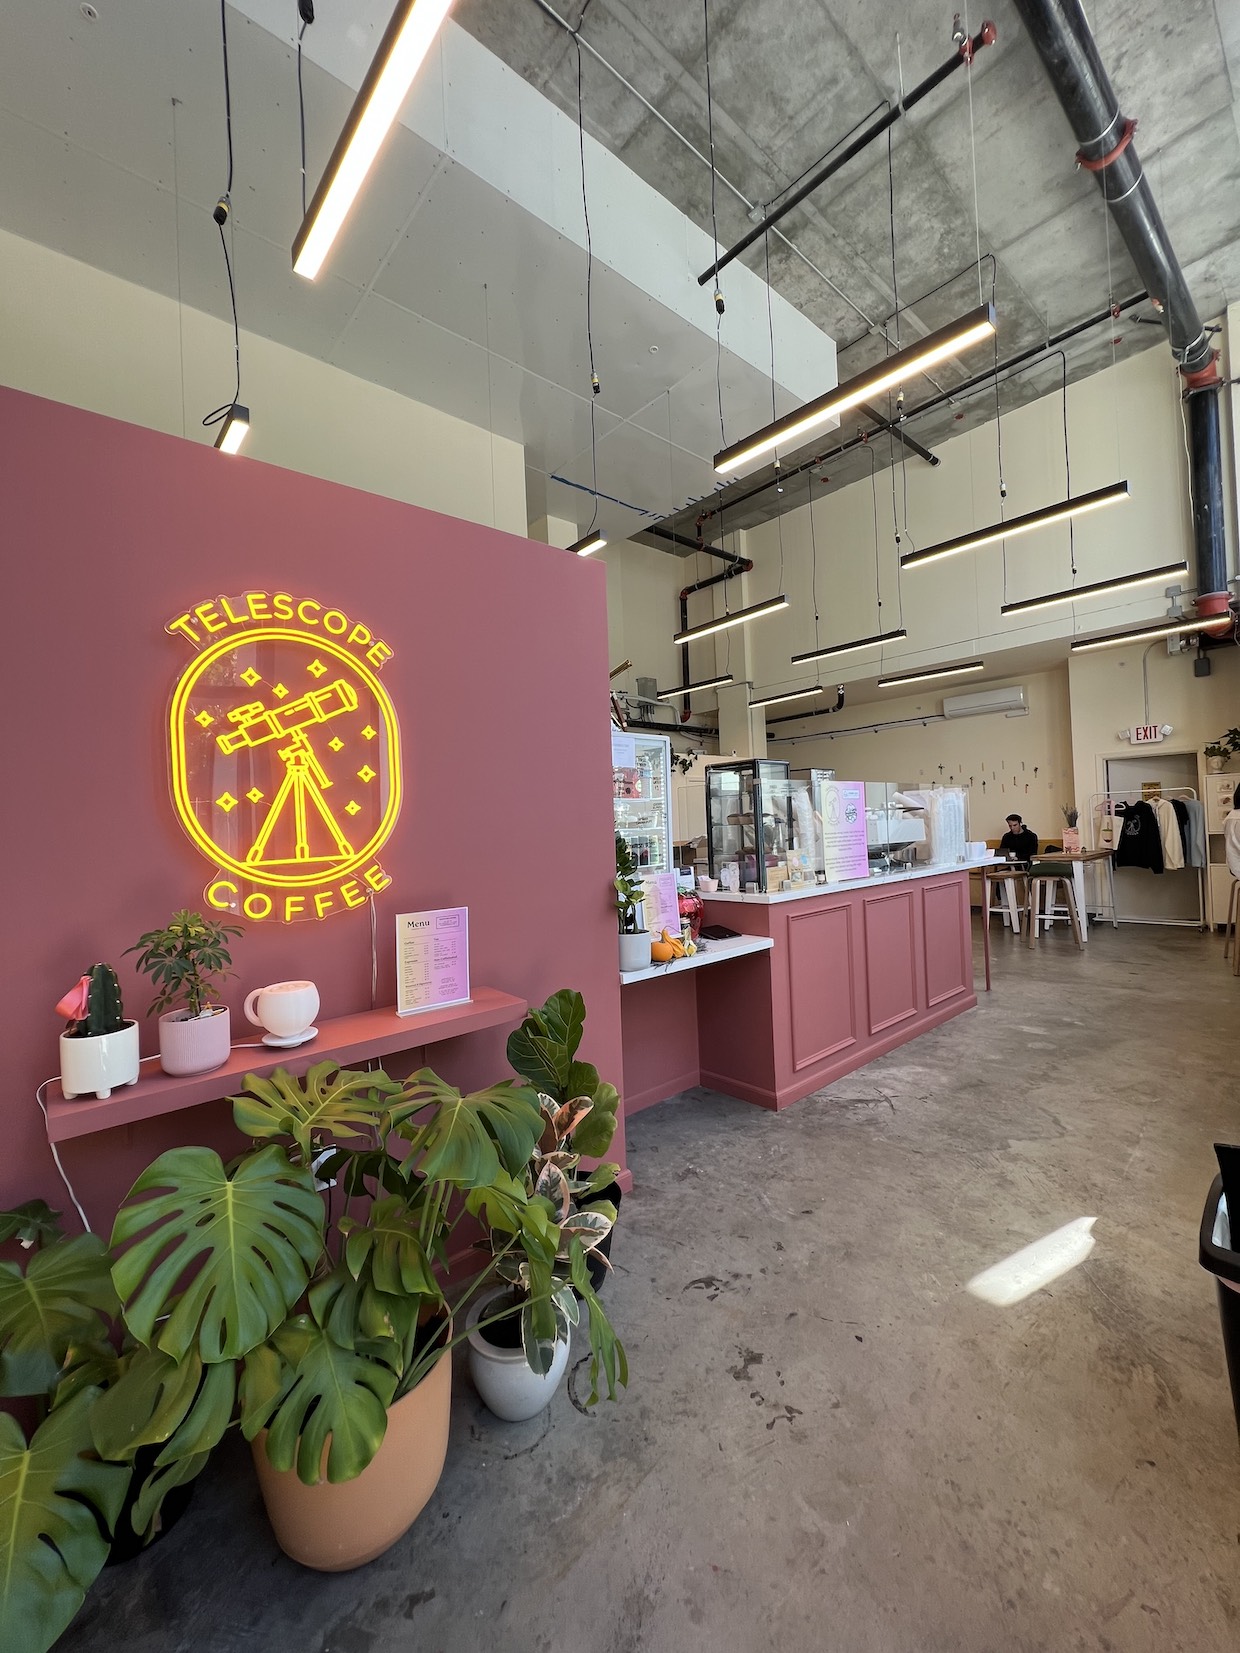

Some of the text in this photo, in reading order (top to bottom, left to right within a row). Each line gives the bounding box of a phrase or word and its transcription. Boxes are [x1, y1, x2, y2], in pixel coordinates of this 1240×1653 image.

[169, 593, 392, 668] TELESCOPE
[1135, 725, 1158, 741] EXIT
[207, 864, 391, 921] COFFEE
